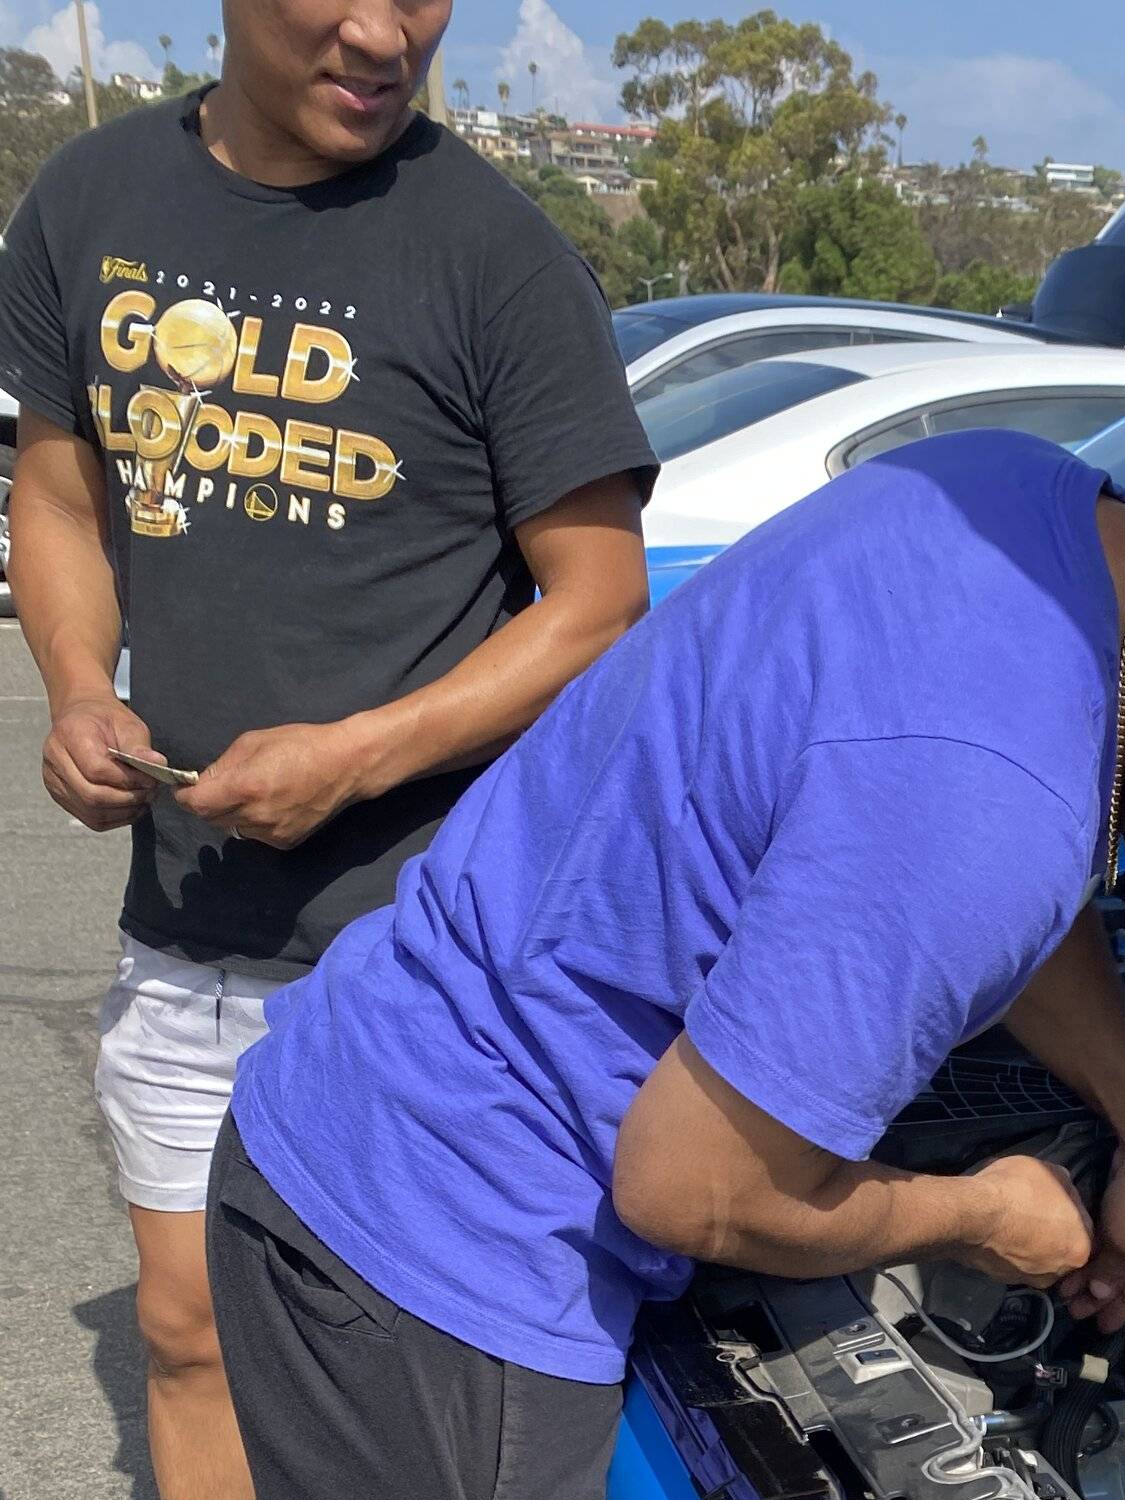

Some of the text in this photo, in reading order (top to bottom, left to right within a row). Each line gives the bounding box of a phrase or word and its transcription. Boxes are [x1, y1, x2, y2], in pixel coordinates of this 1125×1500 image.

[156, 270, 357, 319] 2021-2022
[101, 290, 353, 403] GOLD
[88, 384, 398, 500] LOODED
[116, 458, 346, 530] HAMPIONS
